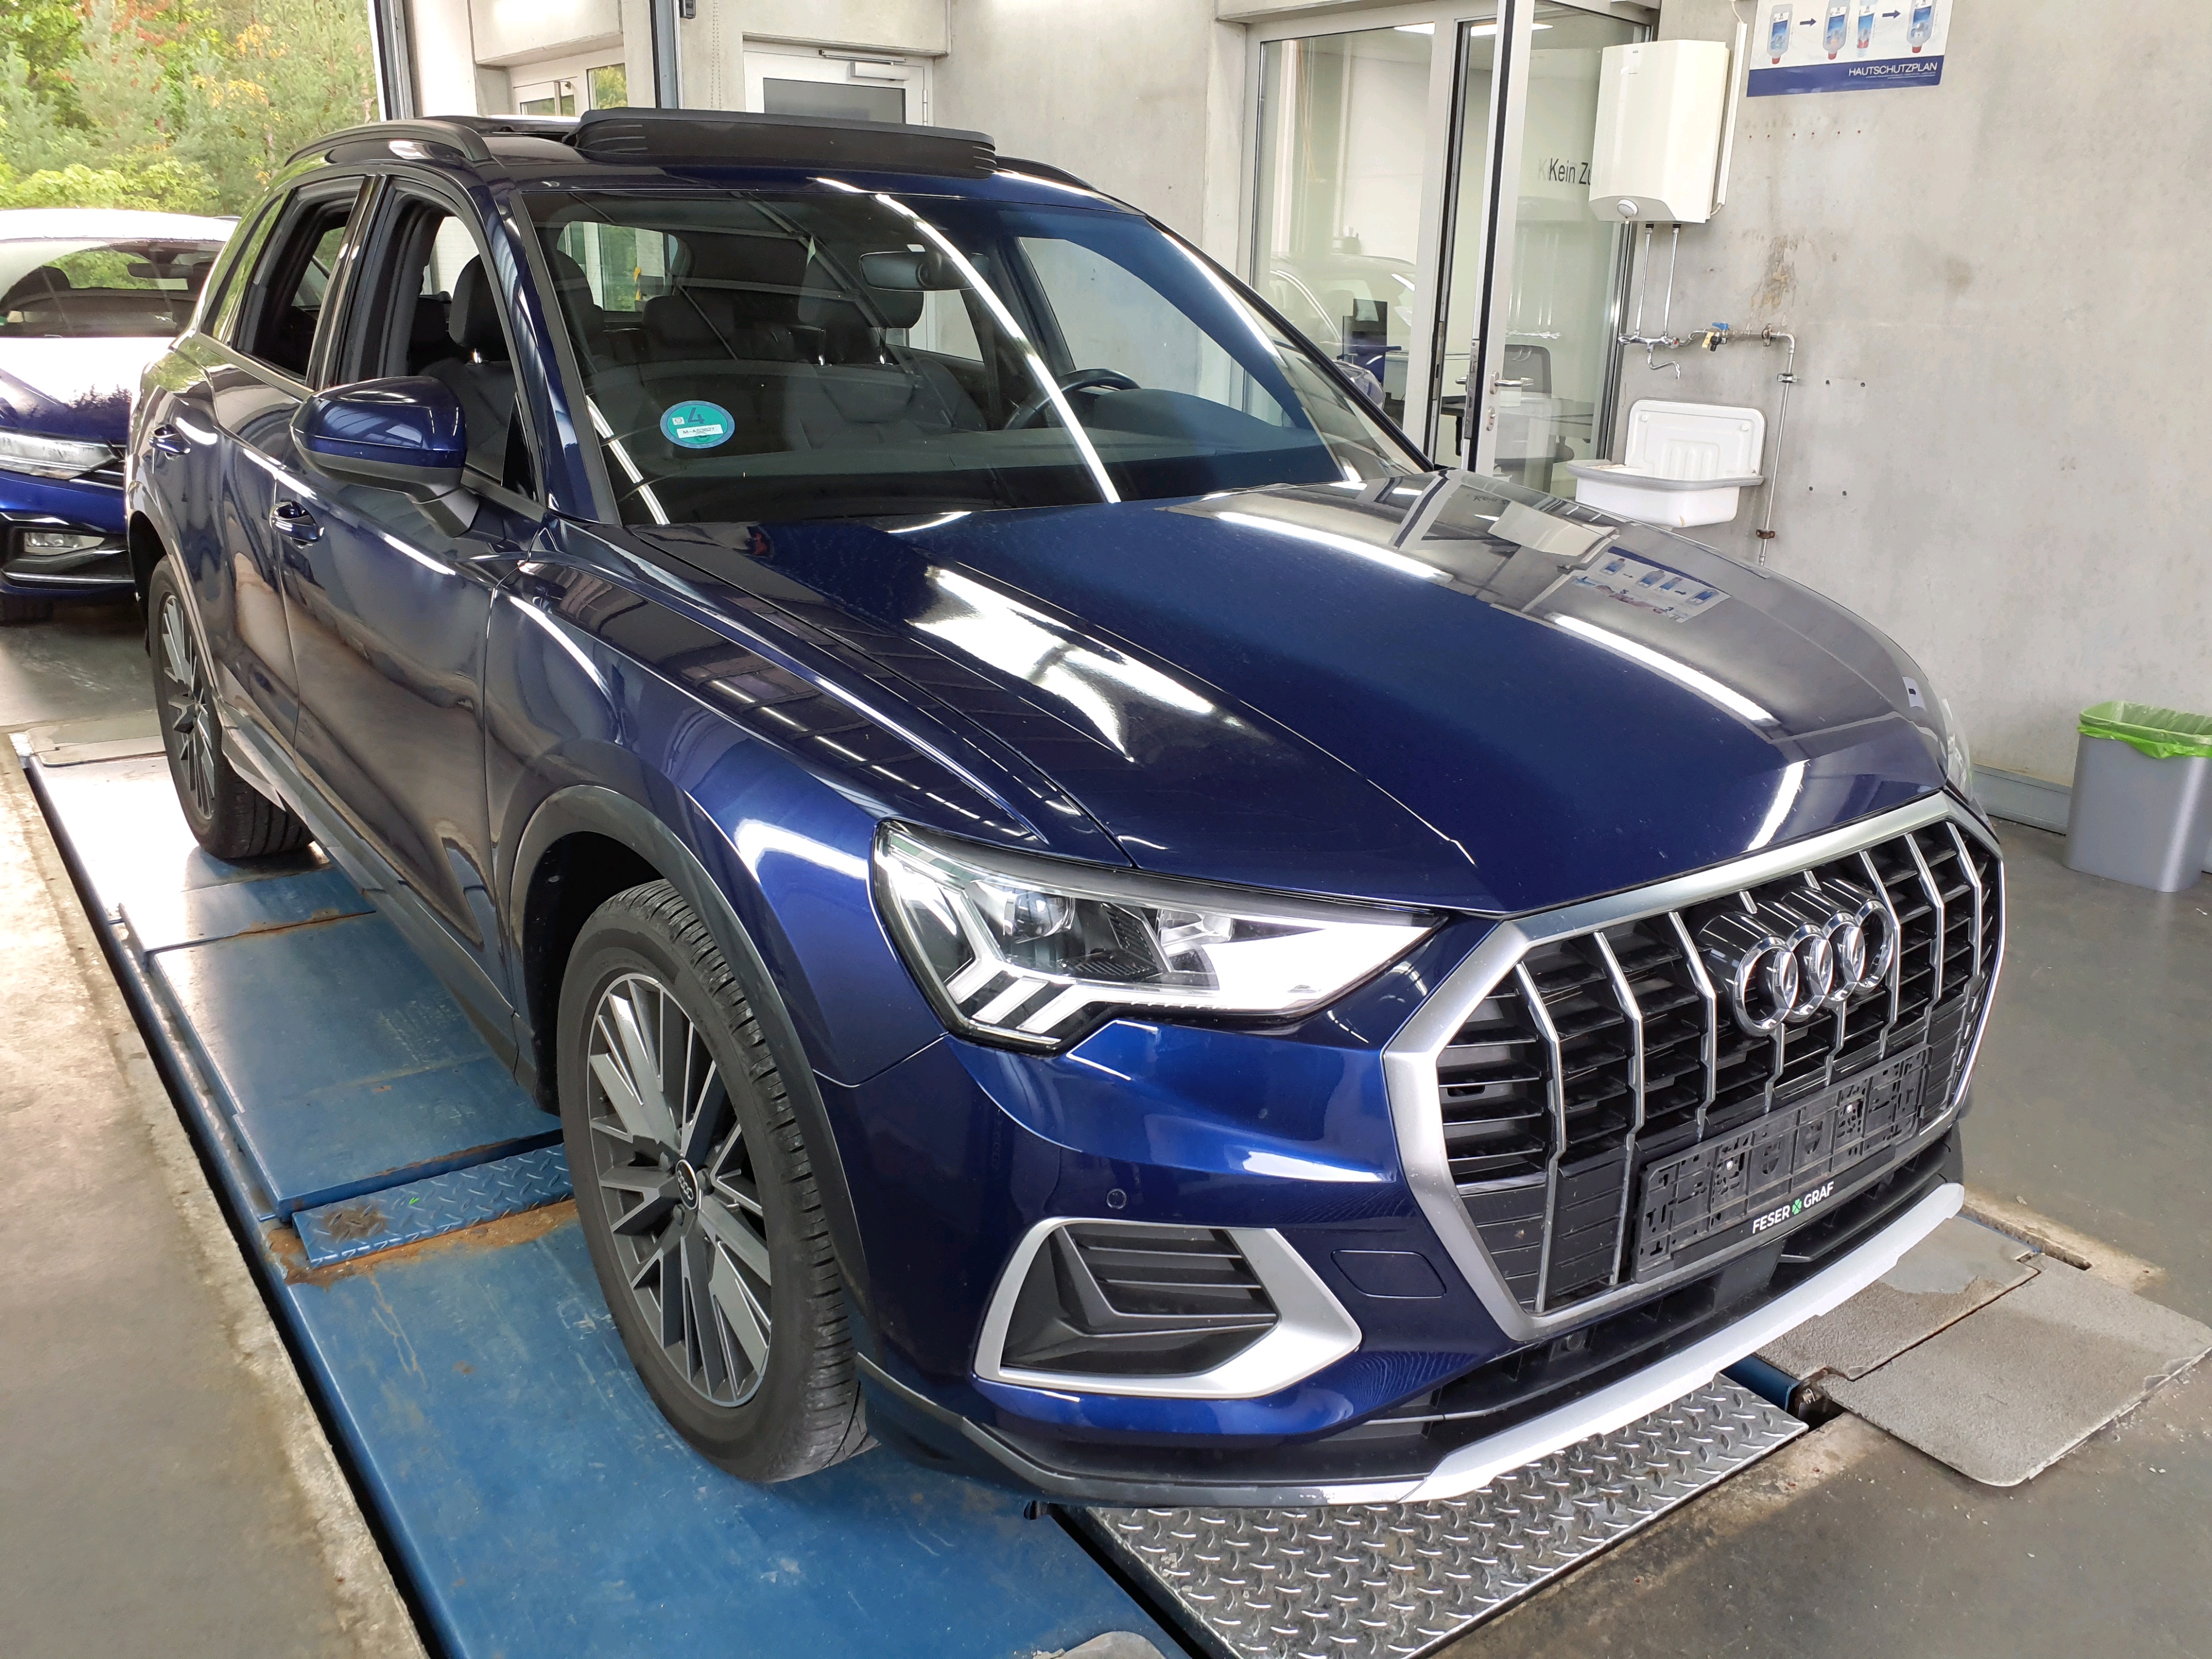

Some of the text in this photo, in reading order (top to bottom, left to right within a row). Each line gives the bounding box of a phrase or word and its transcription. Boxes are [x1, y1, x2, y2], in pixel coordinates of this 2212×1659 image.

[1849, 62, 1938, 76] HAUTSCHUTZPLAN
[1549, 158, 1575, 184] Kein
[688, 407, 706, 424] 4
[1752, 1181, 1834, 1234] FESER GRAF
